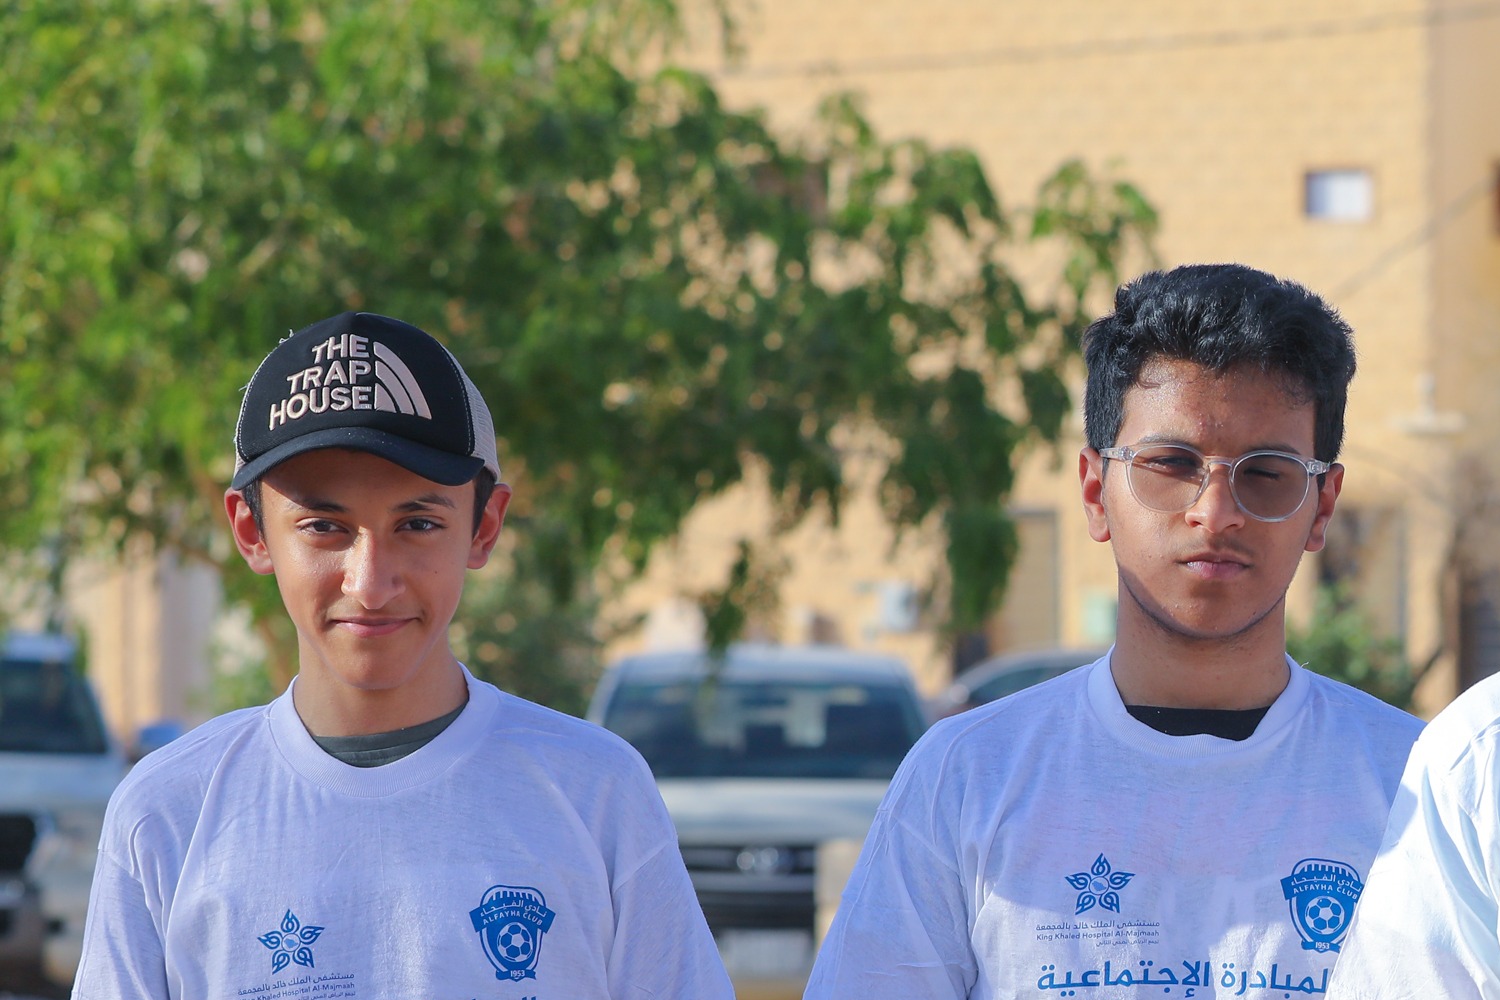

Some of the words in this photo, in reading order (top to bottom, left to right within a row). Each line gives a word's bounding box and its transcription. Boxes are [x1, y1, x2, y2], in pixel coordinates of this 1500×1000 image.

[312, 333, 370, 365] THE
[287, 361, 371, 395] TRAP
[269, 386, 372, 431] HOUSE
[1291, 874, 1336, 886] الفيحاء
[1337, 880, 1362, 892] نادي
[1293, 884, 1333, 894] ALFAYHA
[1337, 887, 1358, 900] CLUB
[481, 900, 523, 917] الفيحاء
[525, 905, 547, 917] نادي
[483, 911, 520, 925] ALFAYHA
[523, 913, 543, 925] CLUB
[1036, 923, 1071, 931] بالمجمعة
[1091, 921, 1115, 929] الملك
[1117, 920, 1160, 930] مستشفى
[1055, 932, 1080, 940] Khaled
[1083, 931, 1113, 940] Hospital
[1115, 930, 1160, 938] Al-Majmaah
[288, 976, 310, 986] الملك
[313, 973, 354, 983] مستشفى
[1037, 960, 1210, 998] الإجتماعية
[1220, 961, 1331, 998] لمبادرة
[238, 983, 271, 996] بالمجمعة
[272, 981, 286, 990] خالد
[282, 987, 311, 997] Hospital
[312, 982, 355, 991] Al-Majmaah
